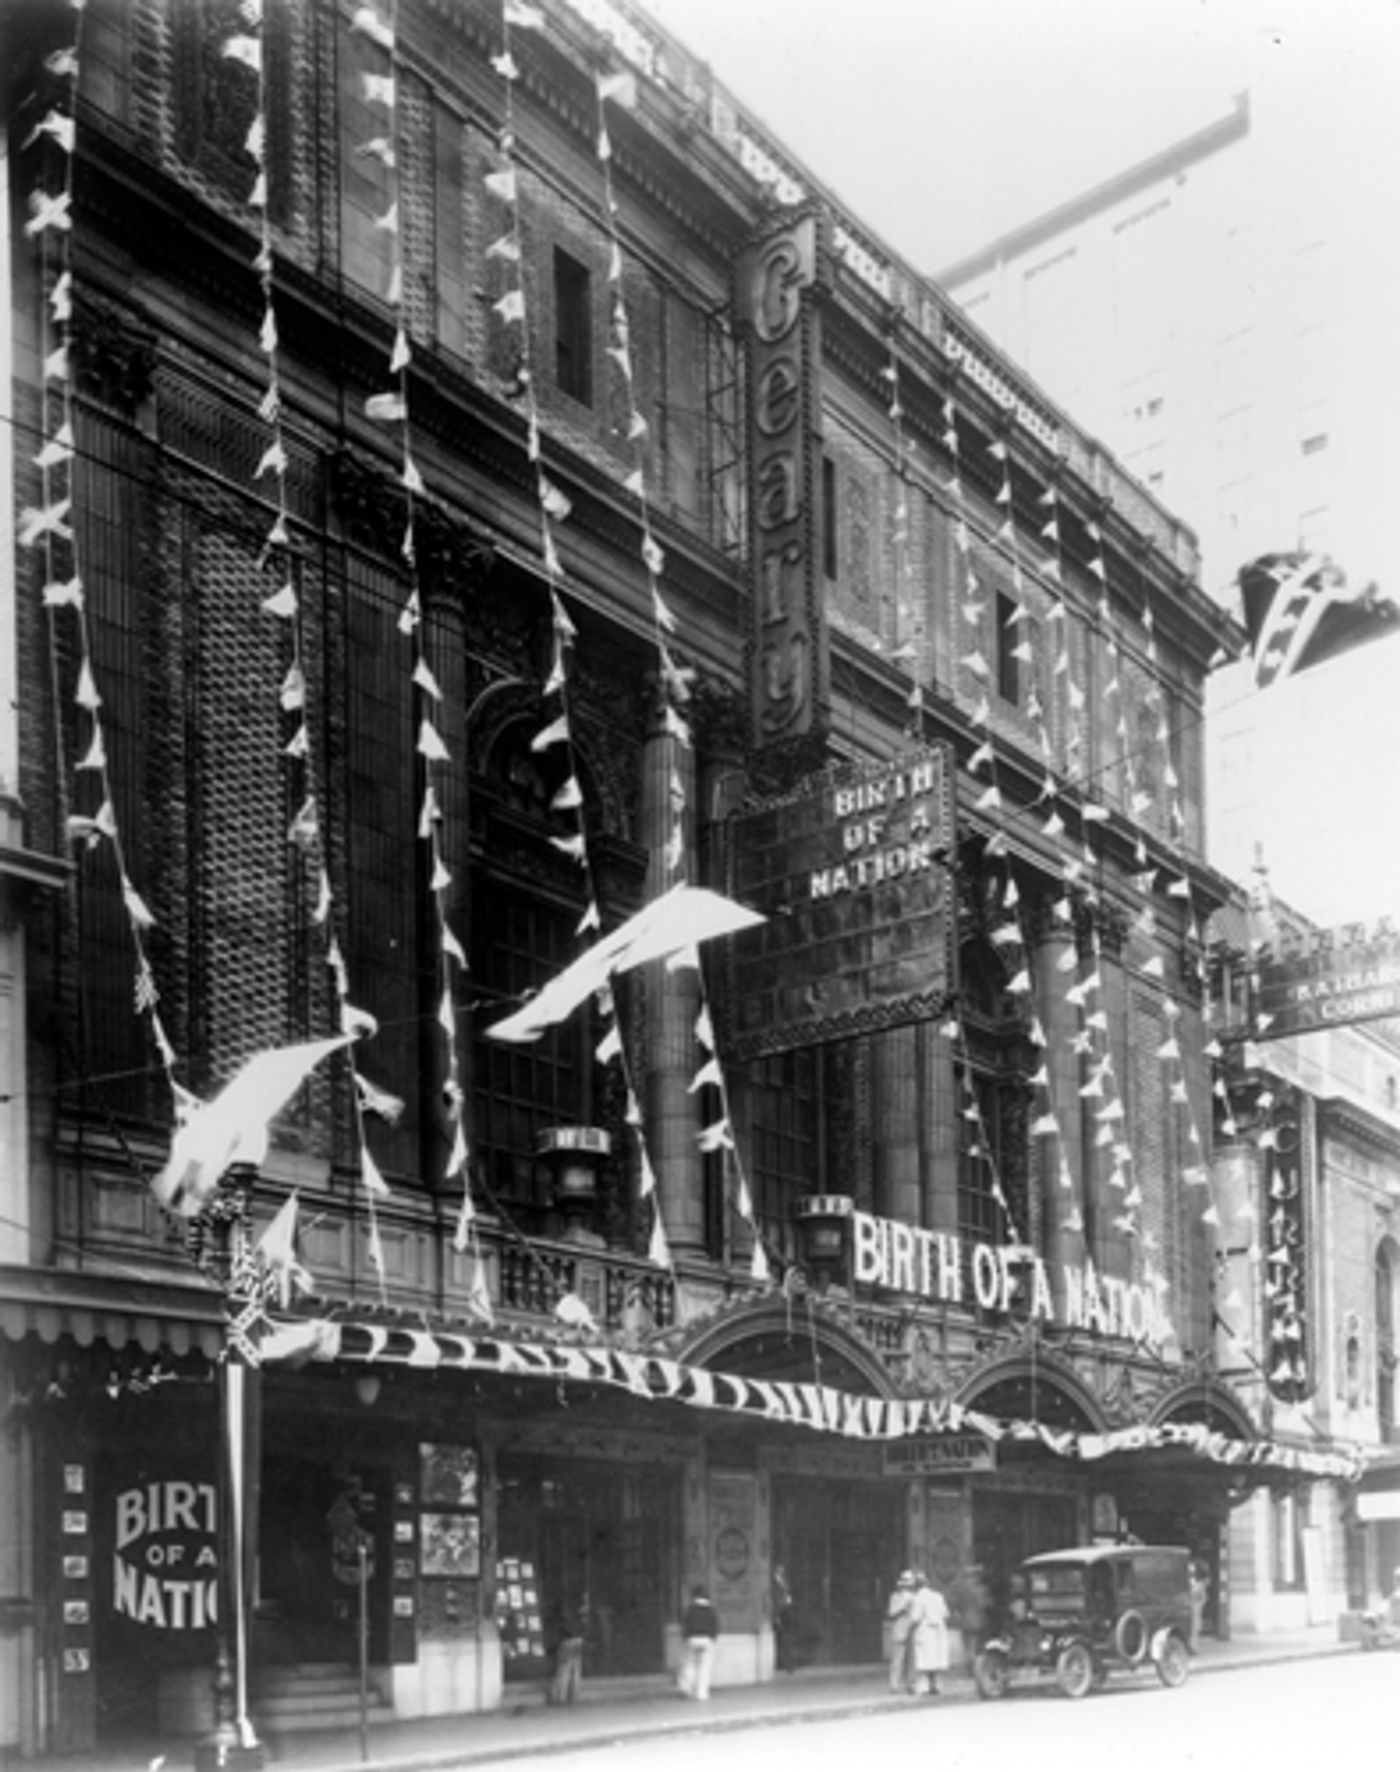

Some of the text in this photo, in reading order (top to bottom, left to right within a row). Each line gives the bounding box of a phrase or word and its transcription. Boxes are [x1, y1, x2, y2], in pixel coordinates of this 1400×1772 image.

[843, 816, 887, 850] OF
[811, 843, 931, 898] NATION
[854, 1210, 961, 1302] BIRTH
[972, 1243, 1030, 1312] OF
[1030, 1257, 1055, 1320] A
[115, 1481, 215, 1550] BIRT
[145, 1545, 217, 1567] OF A
[112, 1552, 218, 1629] NATI
